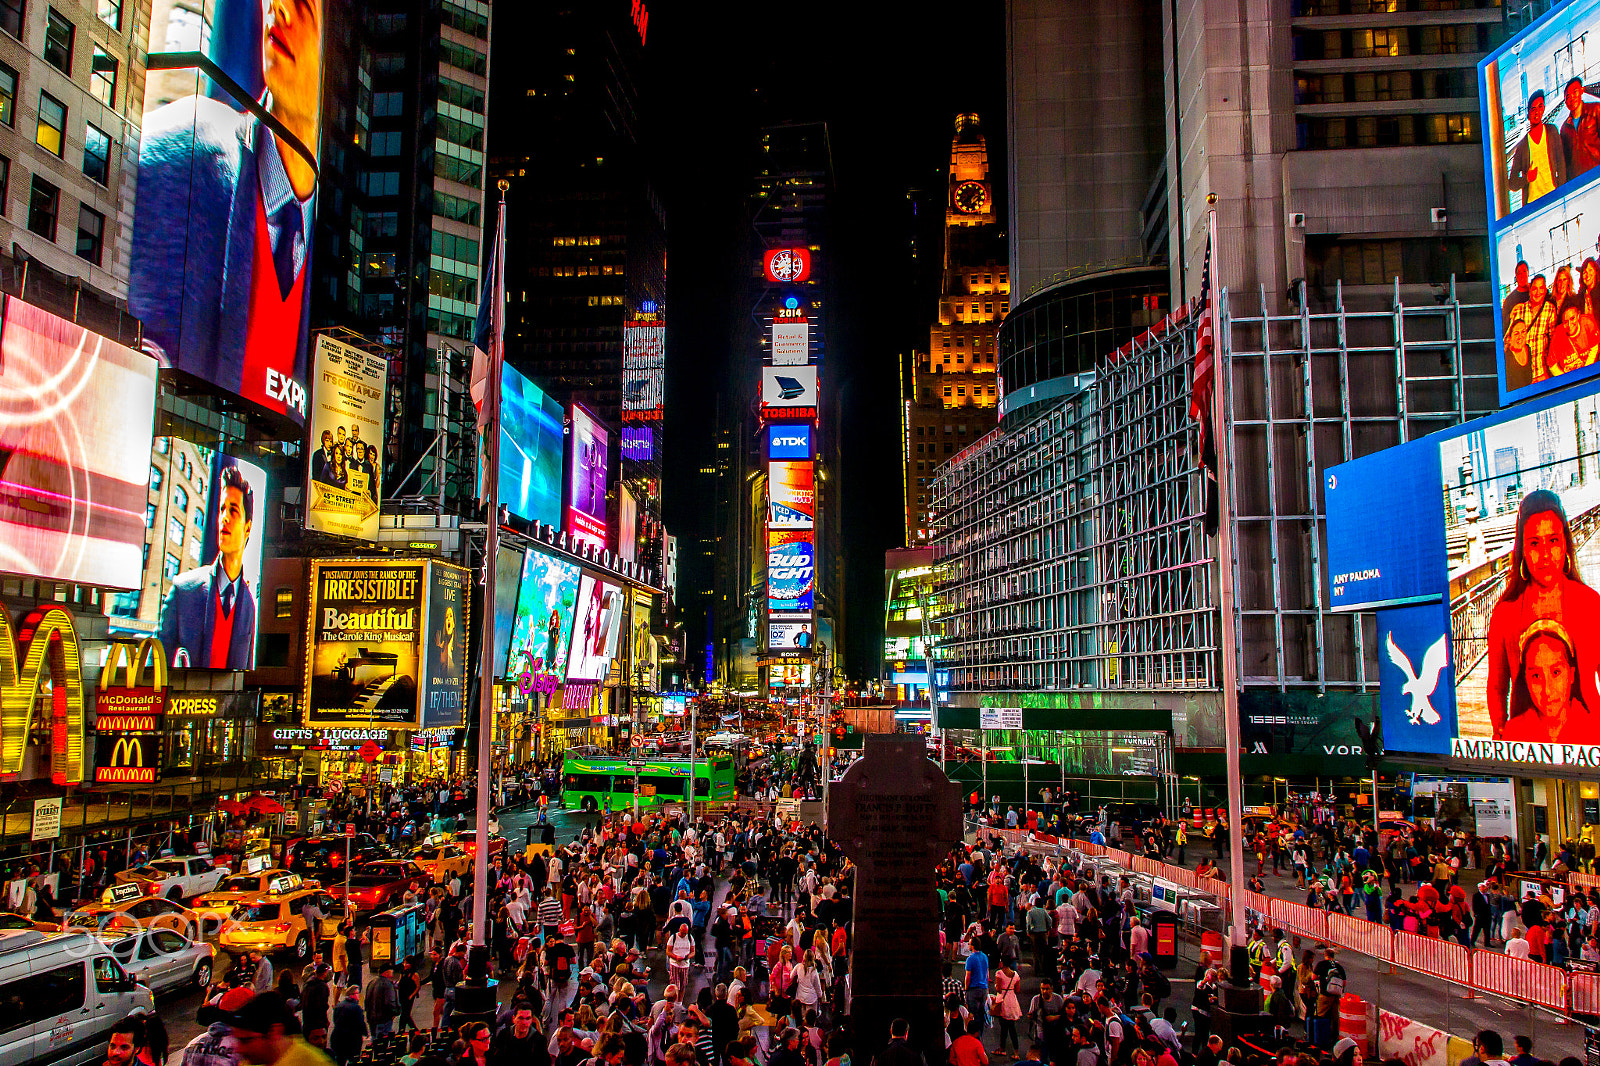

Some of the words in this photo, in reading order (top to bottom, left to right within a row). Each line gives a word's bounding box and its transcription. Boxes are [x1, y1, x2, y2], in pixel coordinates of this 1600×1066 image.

[779, 309, 801, 317] 2014
[338, 379, 357, 392] ONLY
[763, 407, 816, 418] TOSHIBA
[780, 437, 807, 446] TDK
[335, 495, 355, 505] STREET
[776, 504, 790, 515] ICED
[534, 519, 578, 554] 1540
[580, 538, 652, 586] BROADWAY
[769, 553, 811, 567] BUD
[352, 571, 368, 580] JOINS
[369, 571, 378, 579] THE
[379, 571, 397, 579] RANKS
[398, 571, 405, 579] OF
[405, 571, 416, 579] THE
[1333, 573, 1349, 585] AMY
[1349, 568, 1381, 582] PALOMA
[444, 588, 456, 601] LIVE
[1333, 585, 1345, 597] NY
[322, 607, 414, 630] Beautiful
[322, 632, 337, 641] The
[338, 632, 363, 641] Carole
[364, 631, 383, 643] King
[383, 631, 414, 641] Musical
[98, 695, 162, 705] McDonald's
[430, 689, 460, 711] IF/THEN
[562, 684, 594, 709] FOREVER
[167, 698, 217, 715] XPRESS
[1248, 715, 1287, 725] 1535
[273, 728, 313, 740] GIFTS
[323, 729, 388, 740] LUGGAGE
[1452, 739, 1555, 766] AMERICAN
